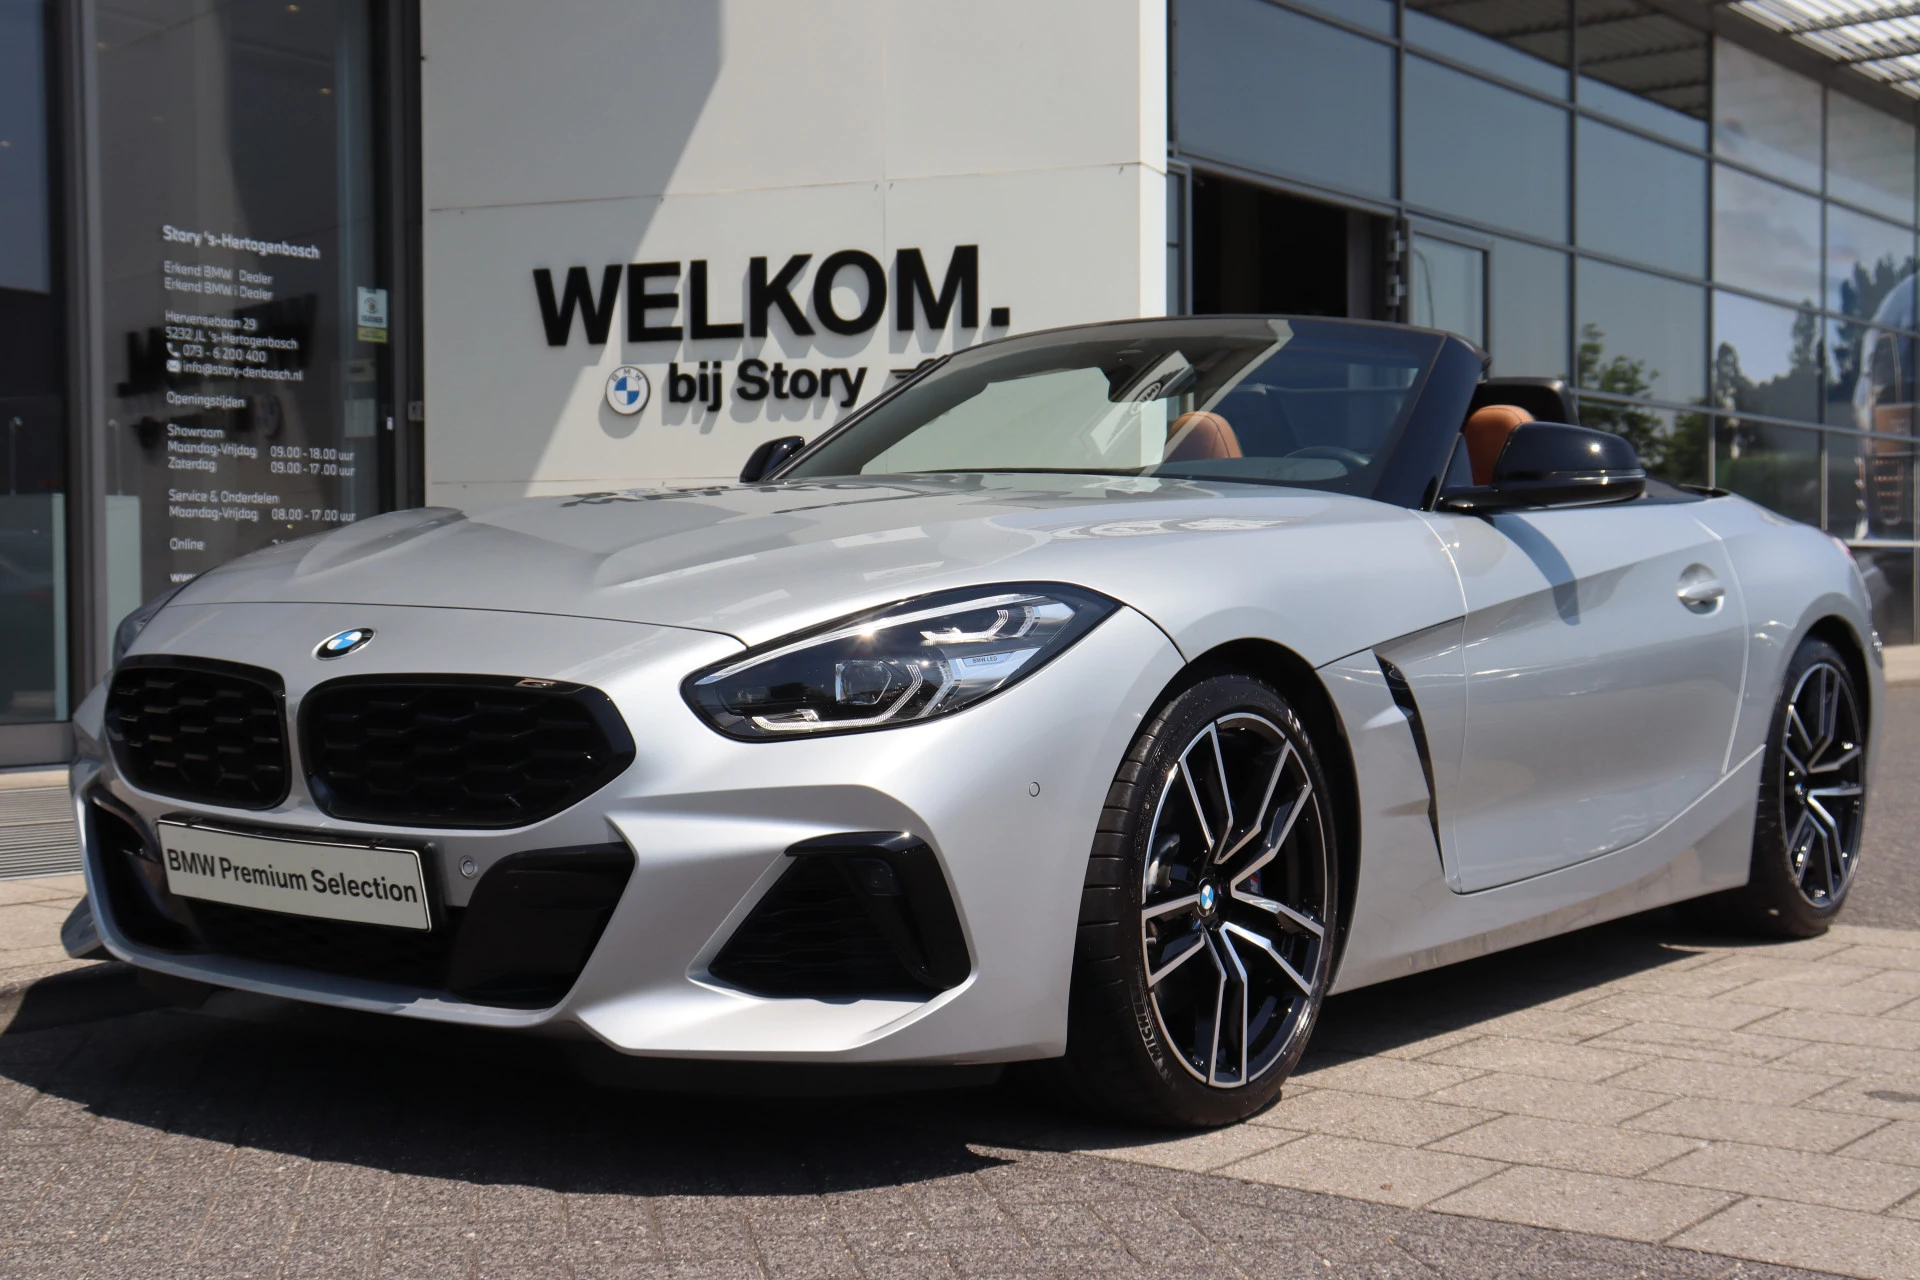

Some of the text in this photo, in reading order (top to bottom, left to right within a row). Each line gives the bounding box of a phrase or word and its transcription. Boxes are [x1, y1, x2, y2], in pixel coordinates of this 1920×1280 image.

[162, 224, 321, 260] Story 's-Hertogenbosch
[164, 260, 274, 285] Erkend BMW Dealer
[164, 276, 201, 292] Erkend
[203, 281, 232, 297] BMW
[239, 285, 274, 301] Dealer
[533, 244, 1010, 347] WELKOM.
[165, 310, 258, 331] Hervensebaan 29
[165, 326, 299, 350] 5232 JL 's-Hertogenbosch
[182, 344, 204, 358] 073
[212, 346, 221, 360] 6
[222, 347, 244, 361] 200
[245, 350, 267, 363] 400
[183, 360, 304, 381] info@story-denbosch.nl
[668, 358, 867, 413] bij Story
[166, 391, 246, 410] Openingstijden
[167, 423, 225, 439] Showroom
[168, 440, 258, 459] Maandag-Vrijdag
[270, 445, 300, 459] 09.00
[309, 447, 337, 460] 18.00
[338, 451, 355, 462] uur
[168, 456, 217, 473] Zaterdag
[270, 461, 300, 474] 09.00
[339, 467, 356, 477] uur
[168, 489, 280, 504] Service & Onderdelen
[169, 505, 259, 523] Maandag-Vrijdag
[271, 508, 302, 521] 08.00
[340, 512, 356, 522] uur
[169, 537, 205, 551] Online
[167, 849, 418, 904] BMW Premium Selection
